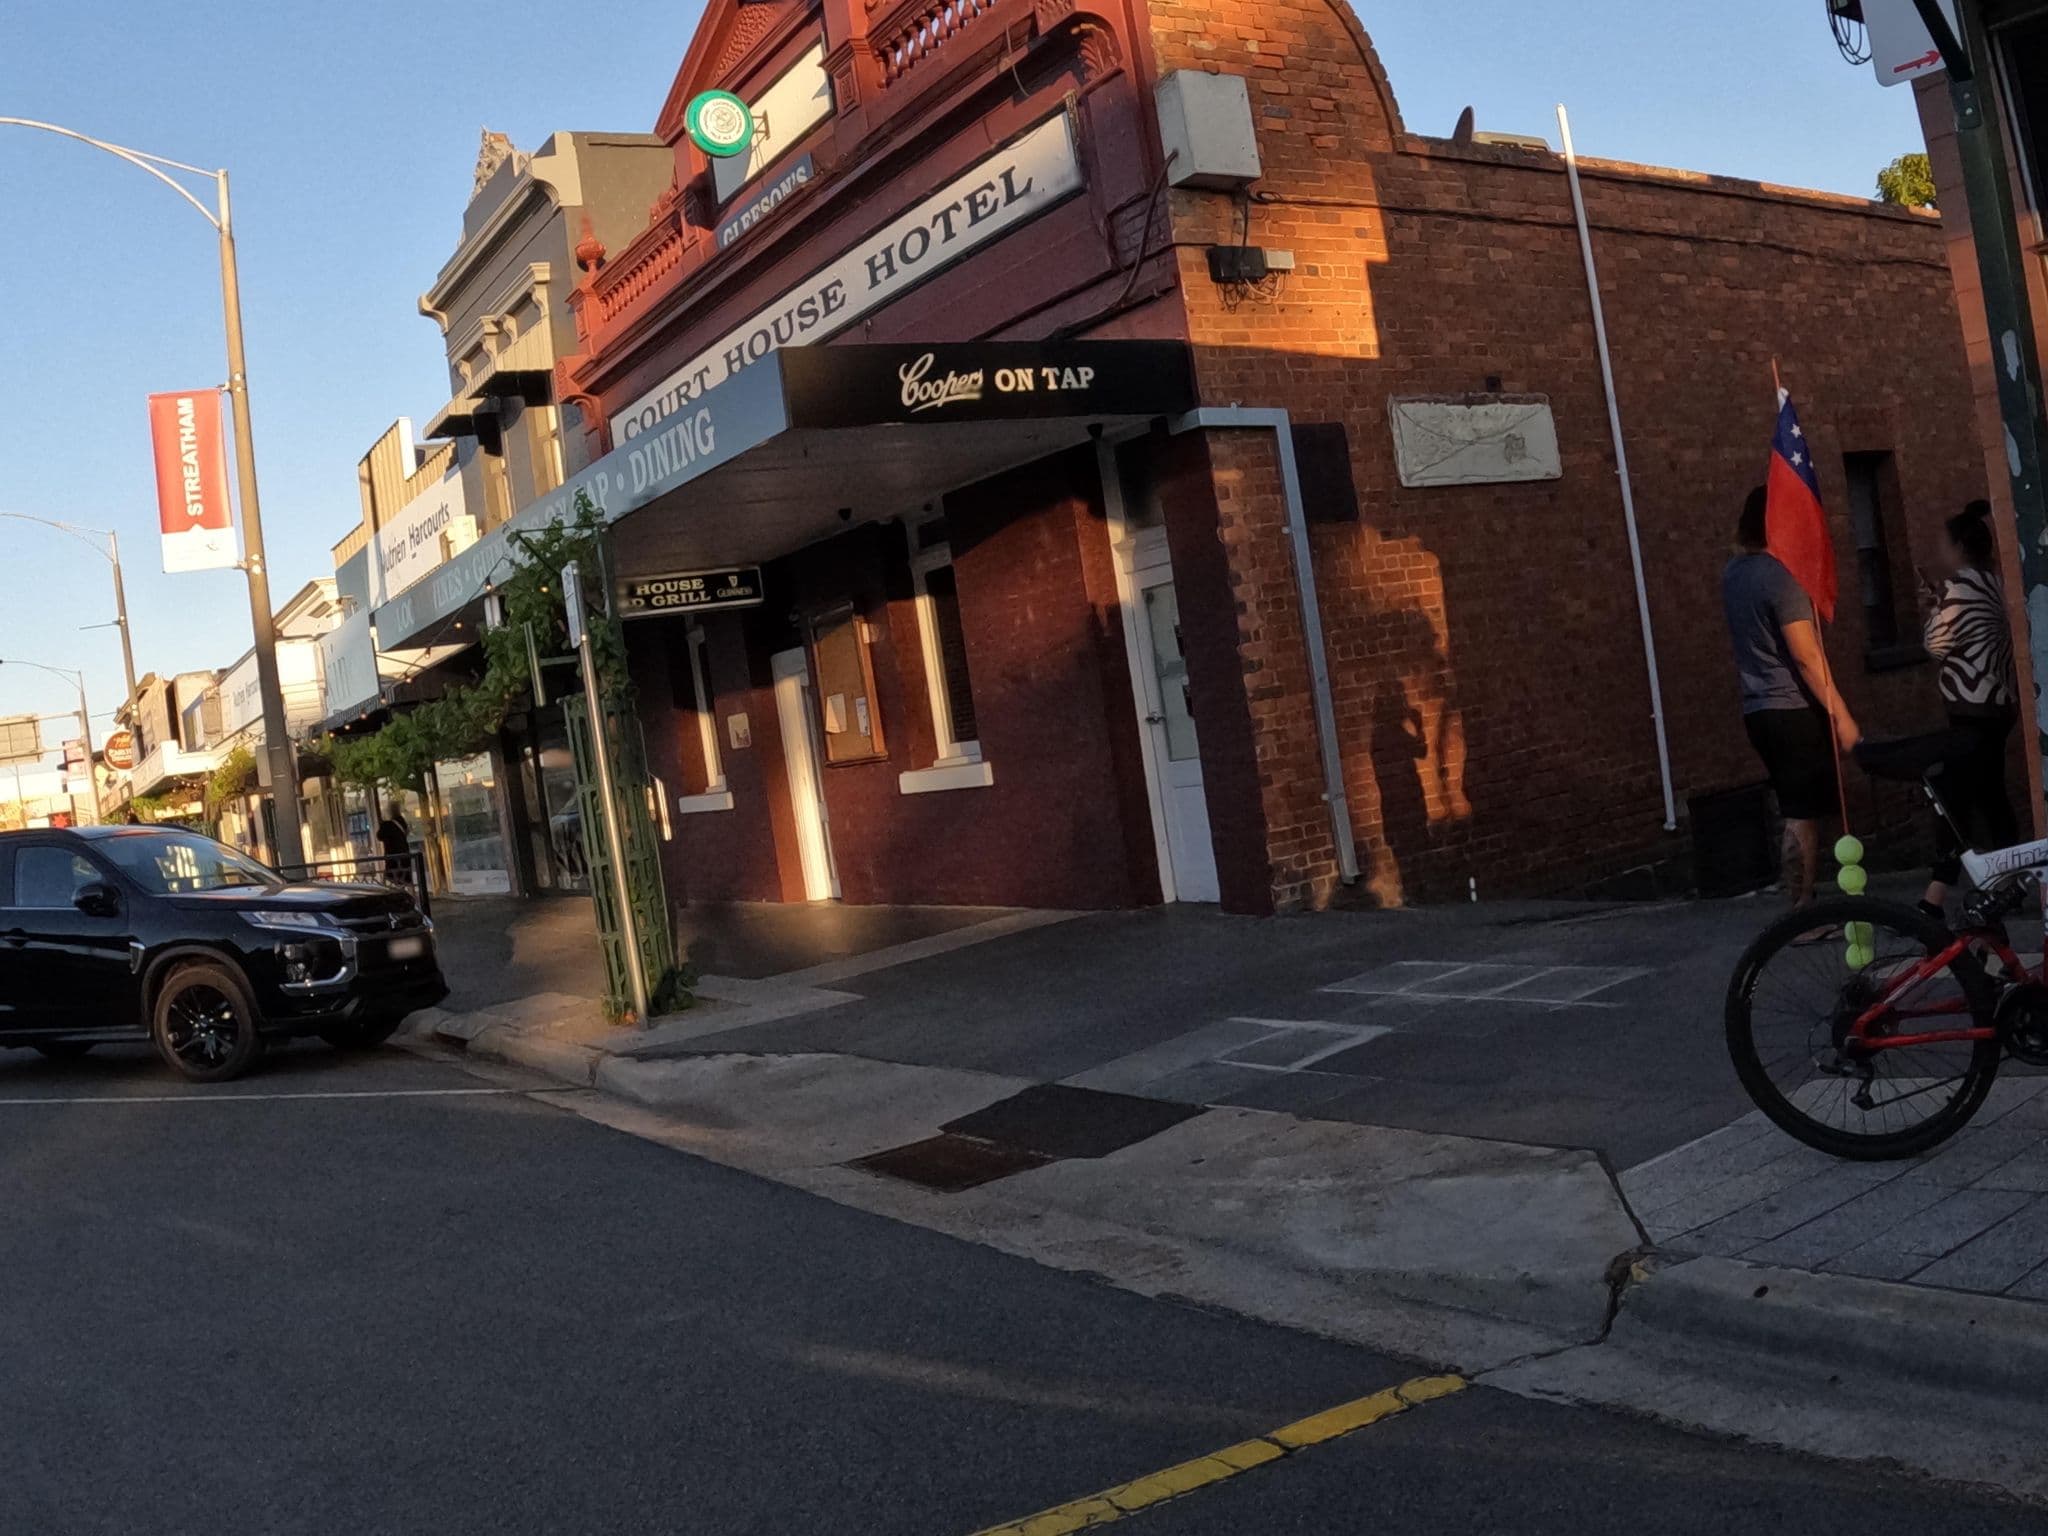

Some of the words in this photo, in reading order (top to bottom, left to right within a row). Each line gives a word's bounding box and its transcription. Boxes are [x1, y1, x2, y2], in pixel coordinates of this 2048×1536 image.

[624, 366, 710, 441] COURT
[723, 278, 847, 376] HOUSE
[864, 165, 1033, 290] HOTEL
[899, 353, 984, 409] Coopers
[995, 367, 1035, 392] ON
[1041, 367, 1095, 390] TAP
[177, 397, 204, 517] STREATHAM
[628, 407, 715, 494] DINING
[408, 501, 450, 551] Harcourts
[636, 578, 705, 596] HOUSE
[651, 590, 711, 607] GRILL
